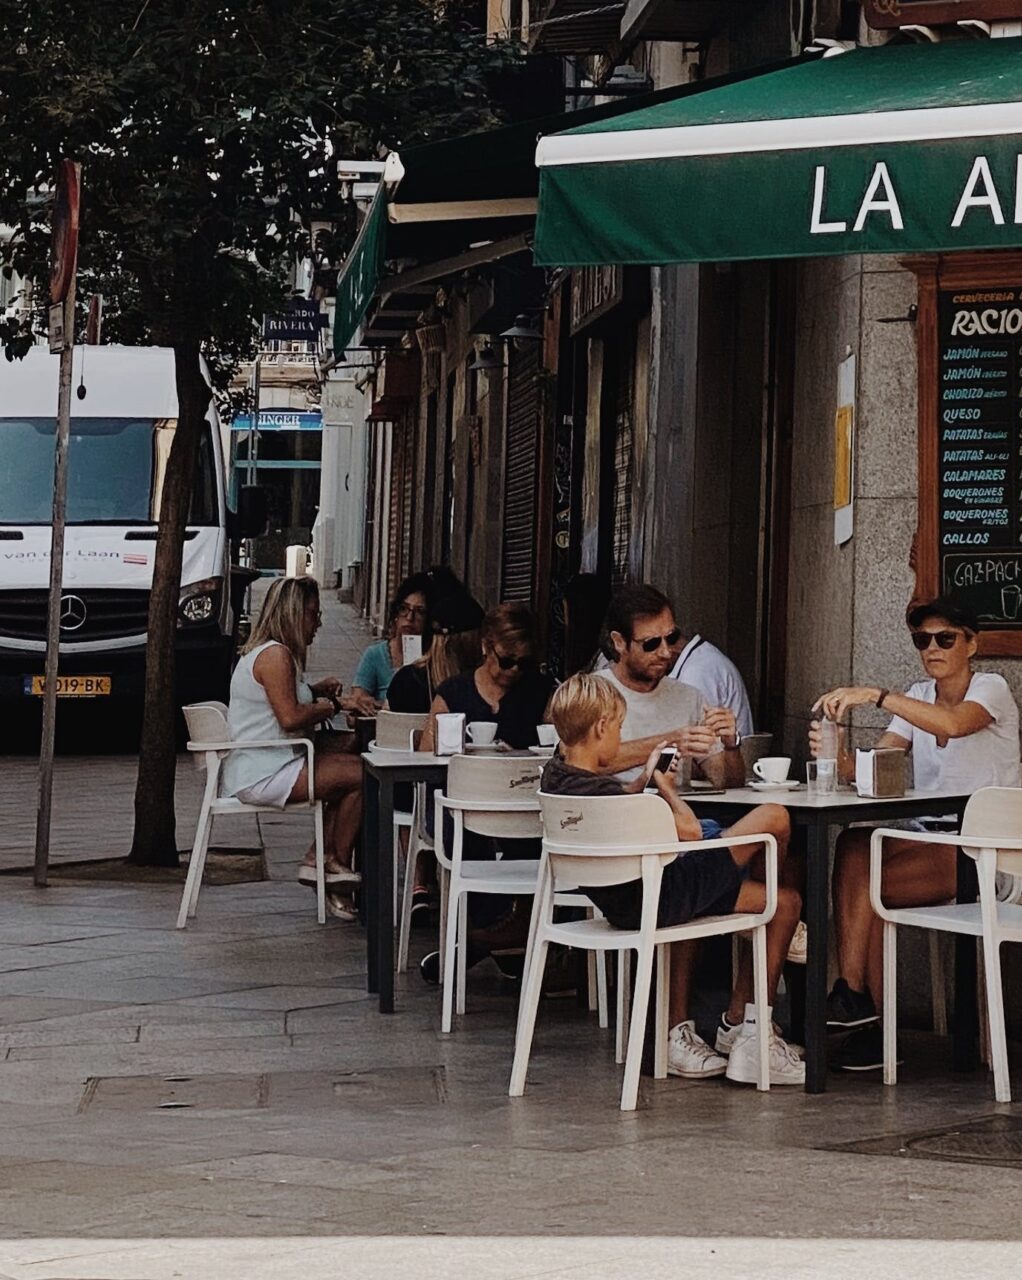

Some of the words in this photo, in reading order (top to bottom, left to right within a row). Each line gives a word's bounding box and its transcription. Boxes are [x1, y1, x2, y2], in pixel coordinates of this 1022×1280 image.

[809, 159, 905, 235] LA
[952, 291, 1014, 304] CERVECERIA
[269, 320, 315, 332] RIVERA
[943, 345, 979, 360] JAMÓN
[943, 365, 982, 381] JAMÓN
[943, 388, 983, 400] CHORIZO
[943, 408, 981, 423] QUESO
[943, 429, 983, 441] PATATAS
[943, 449, 984, 462] PATATAS
[943, 469, 1006, 482] CALAMARES
[943, 487, 1004, 500] BOQUERONES
[943, 508, 1009, 522] BOQUERONES
[943, 532, 989, 545] CALLOS
[4, 551, 37, 559] van
